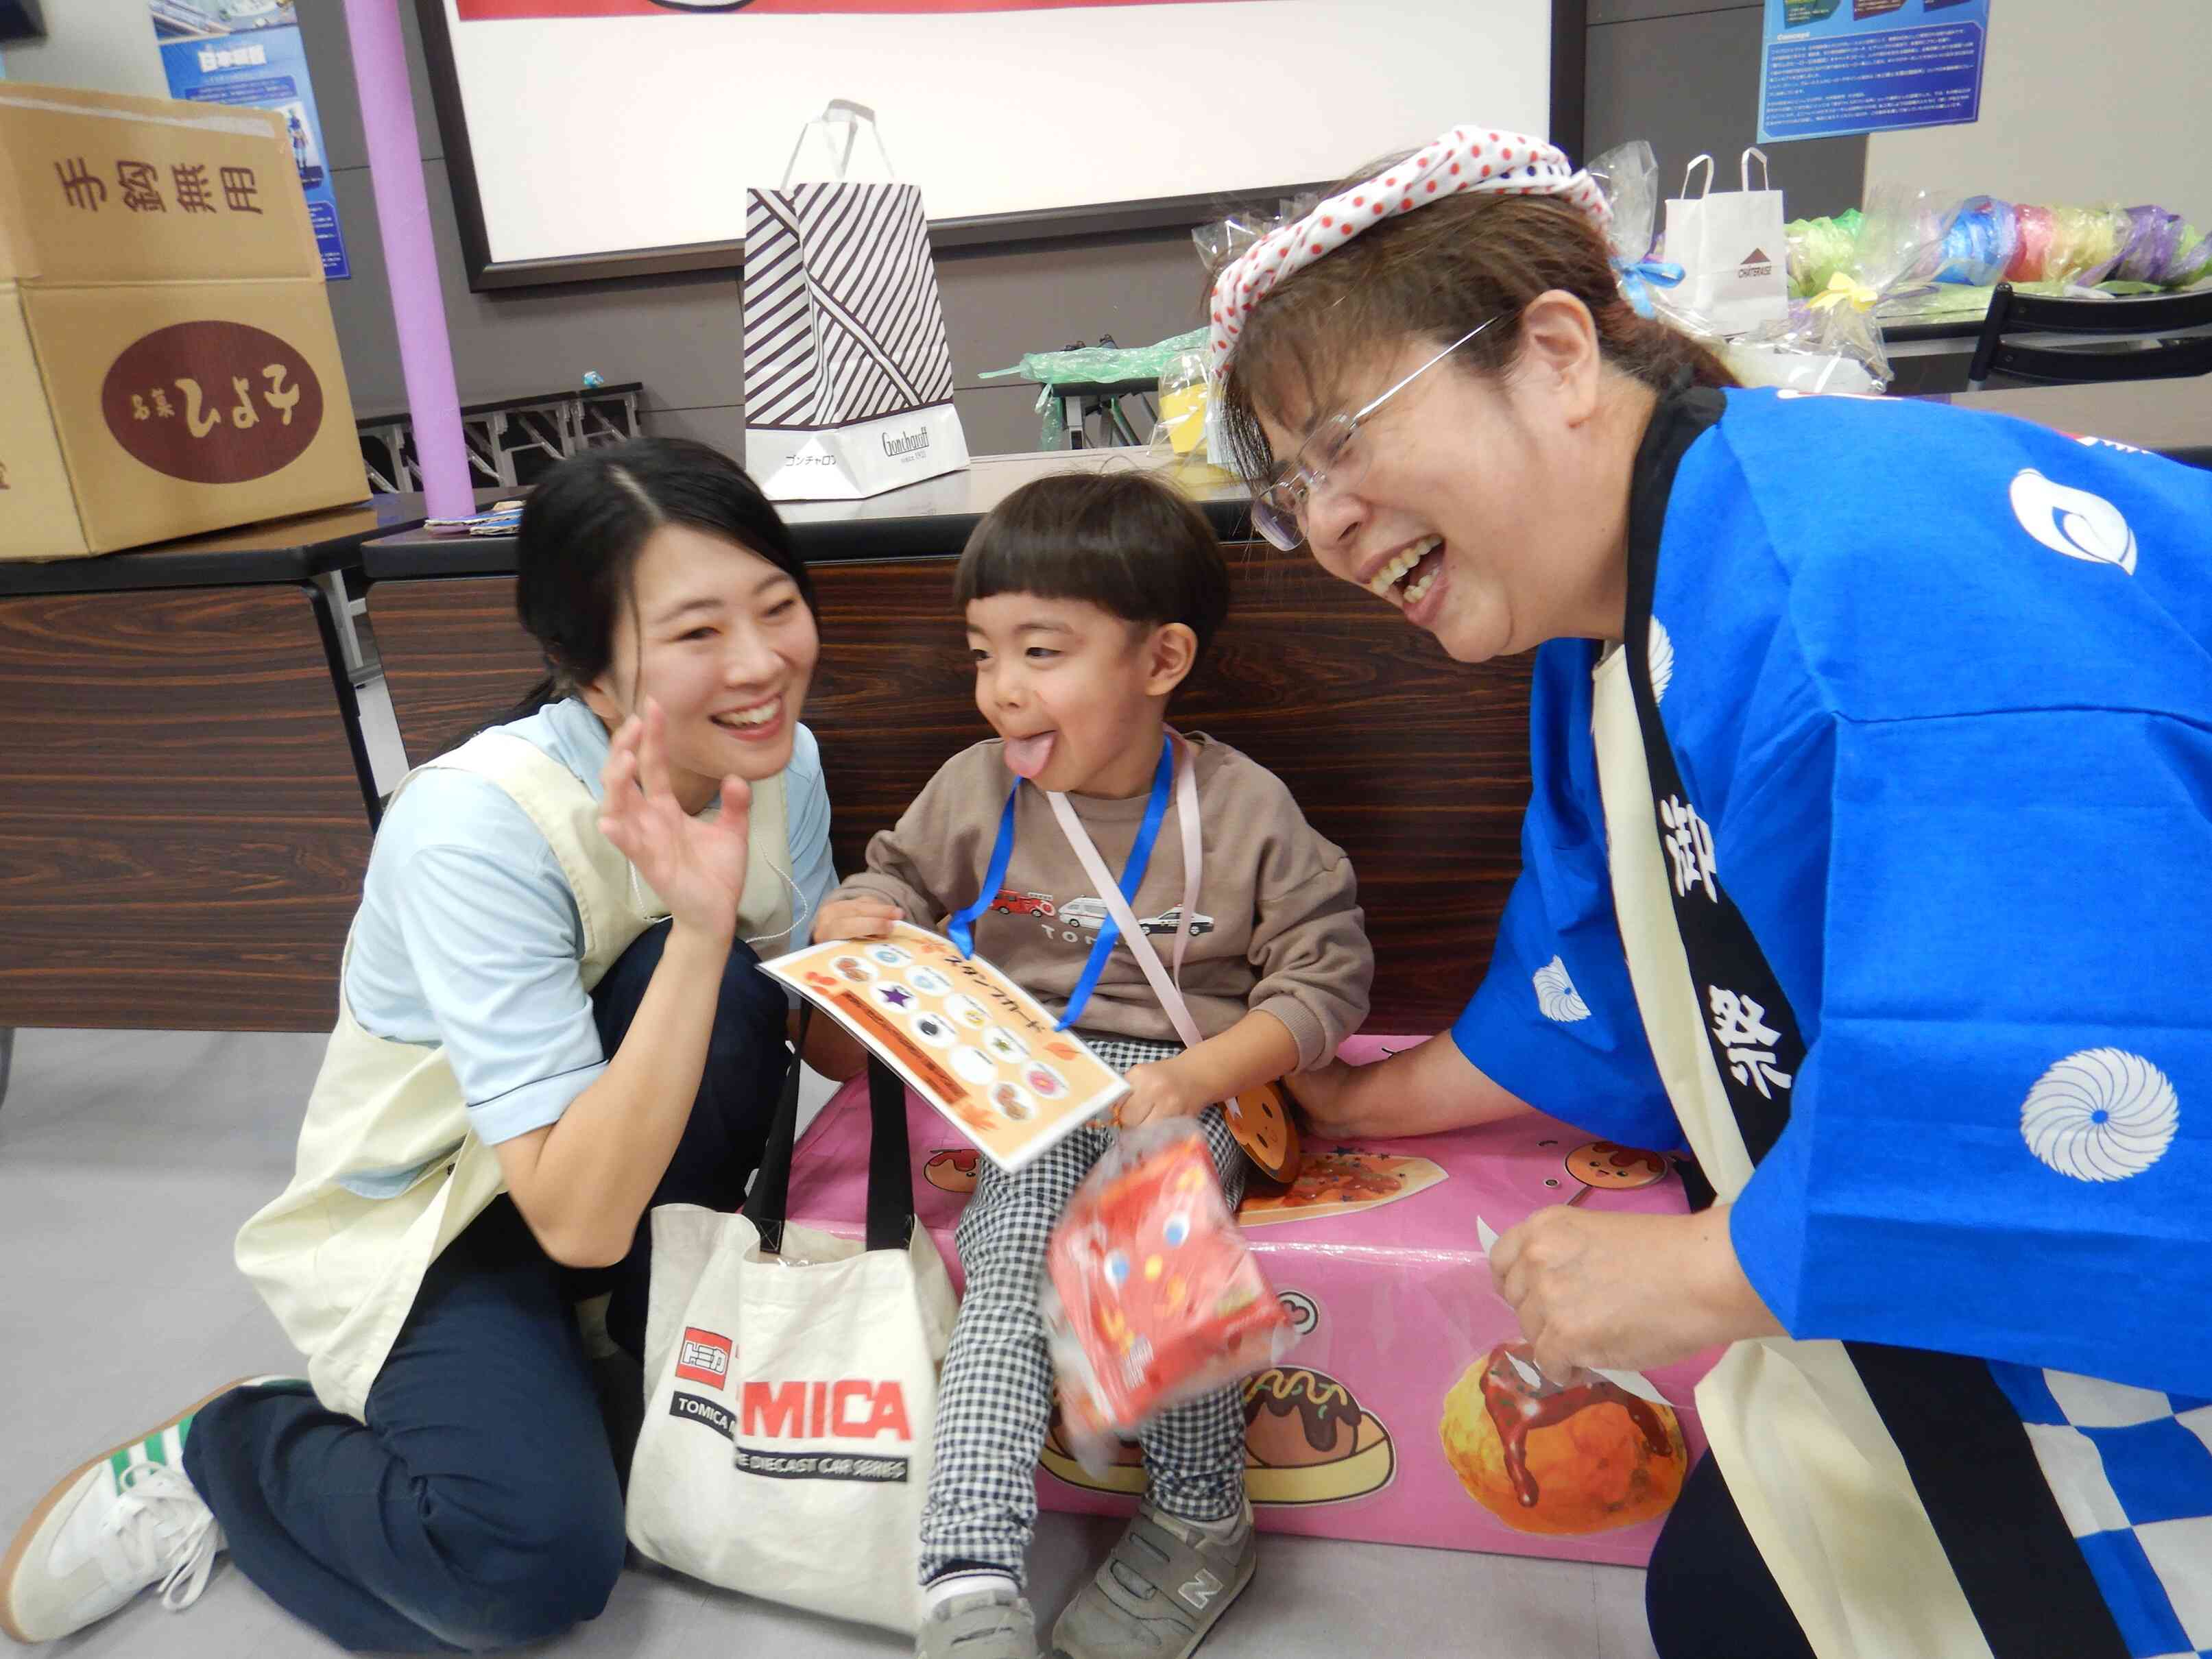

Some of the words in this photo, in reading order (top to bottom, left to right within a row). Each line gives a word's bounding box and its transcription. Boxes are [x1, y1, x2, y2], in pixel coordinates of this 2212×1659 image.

[174, 363, 301, 438] ひよ子
[678, 1397, 728, 1429] TOMICA
[742, 1380, 912, 1441] MICA
[750, 1455, 819, 1473] DIECAST
[818, 1457, 854, 1475] CAR
[853, 1458, 906, 1479] SERIES
